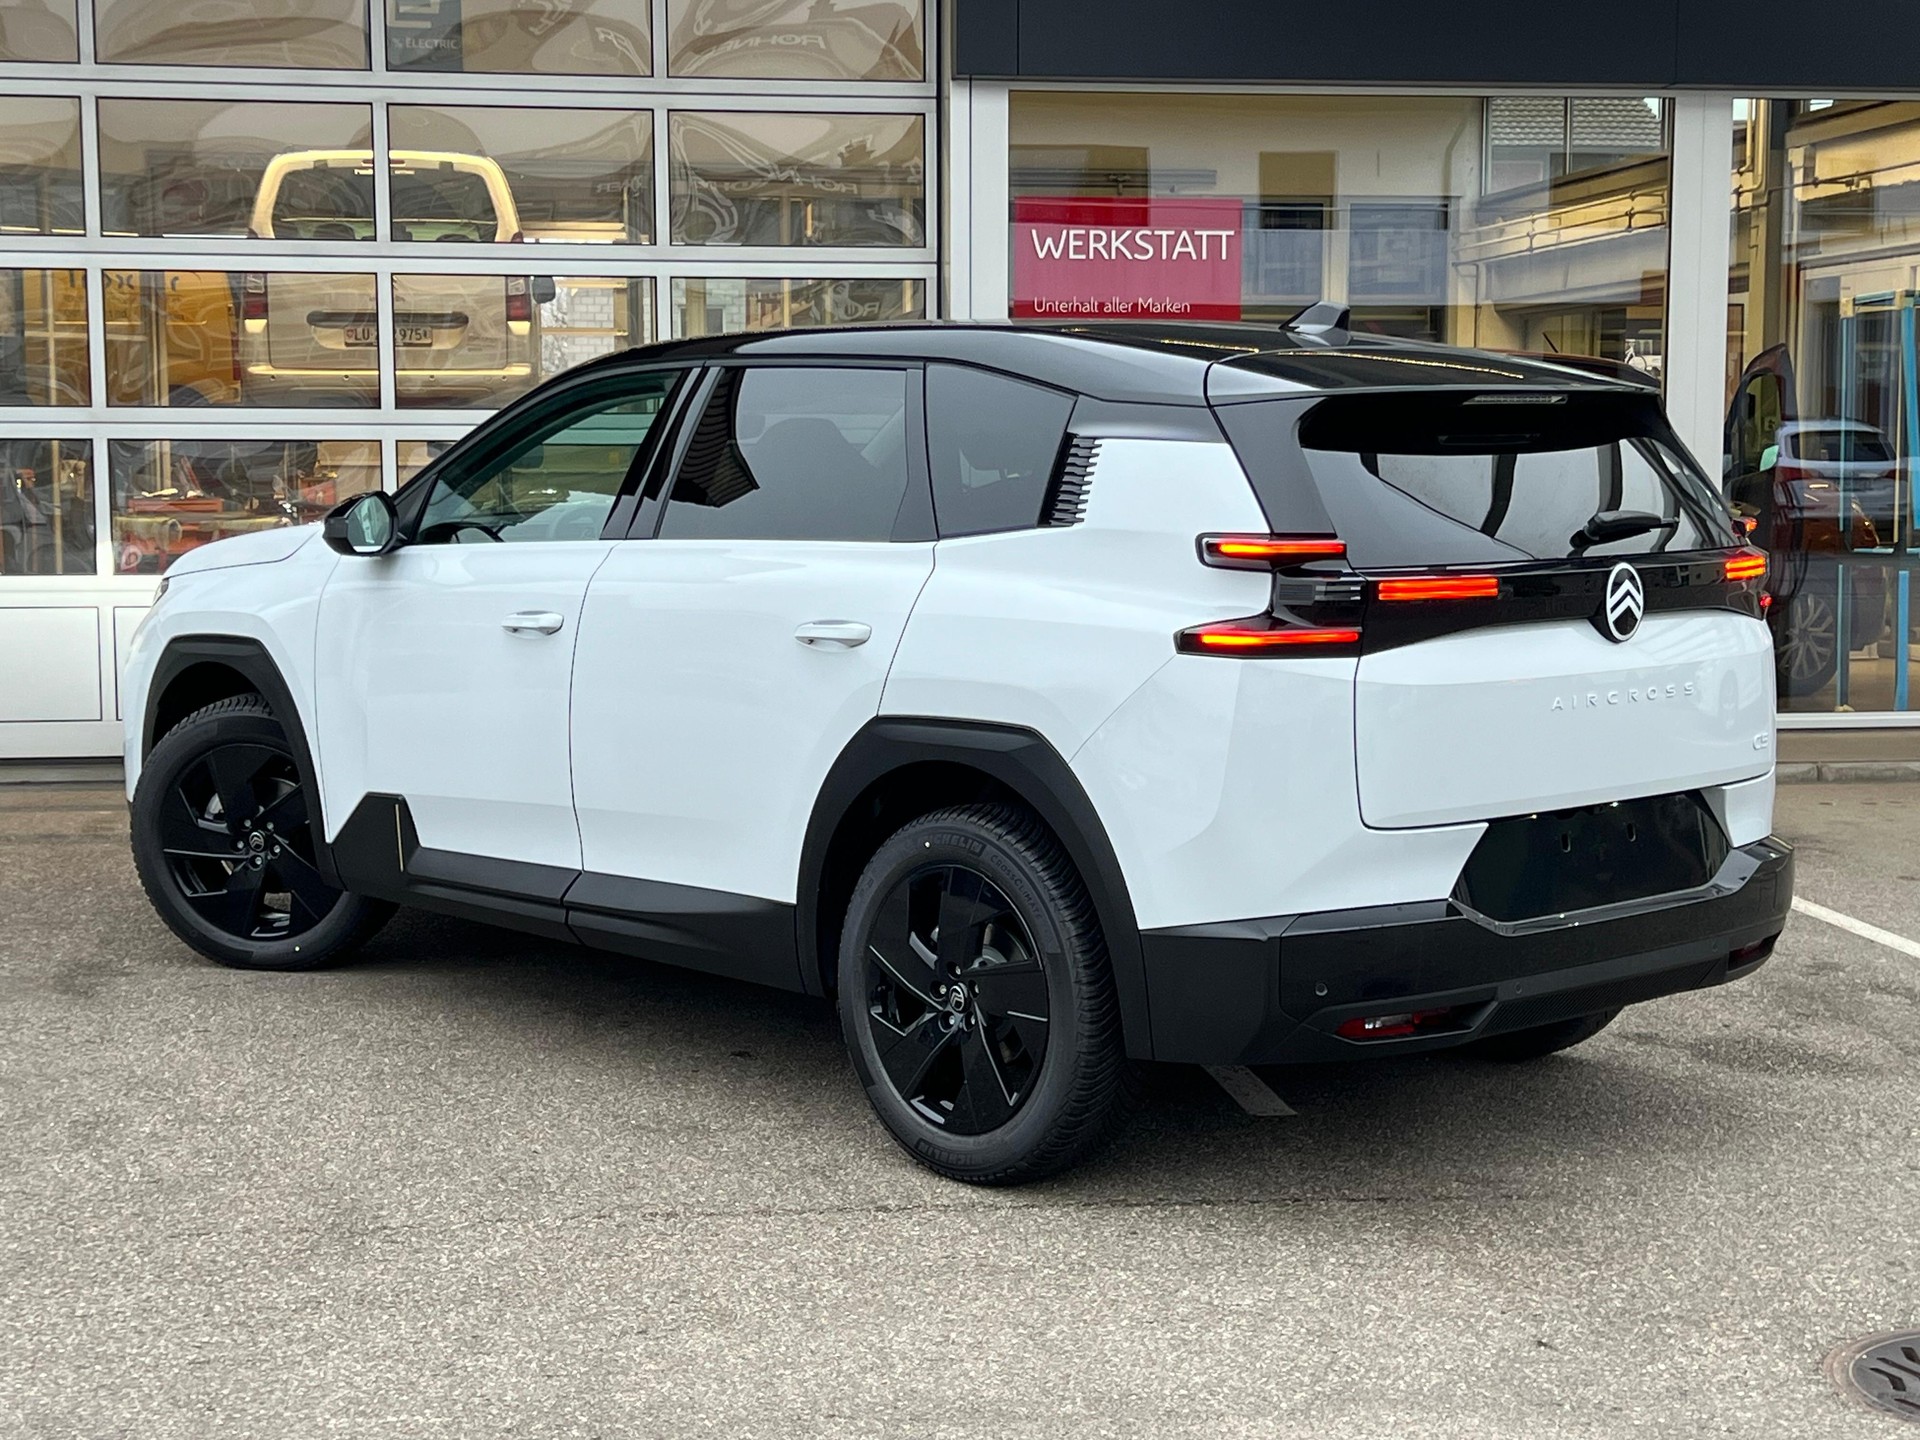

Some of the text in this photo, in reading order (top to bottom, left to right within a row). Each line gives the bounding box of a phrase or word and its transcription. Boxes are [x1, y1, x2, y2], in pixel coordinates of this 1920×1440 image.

[1031, 229, 1235, 260] WERKSTATT
[1034, 297, 1191, 313] Unterhalt aller Marken
[1551, 681, 1695, 711] AIRCROSS
